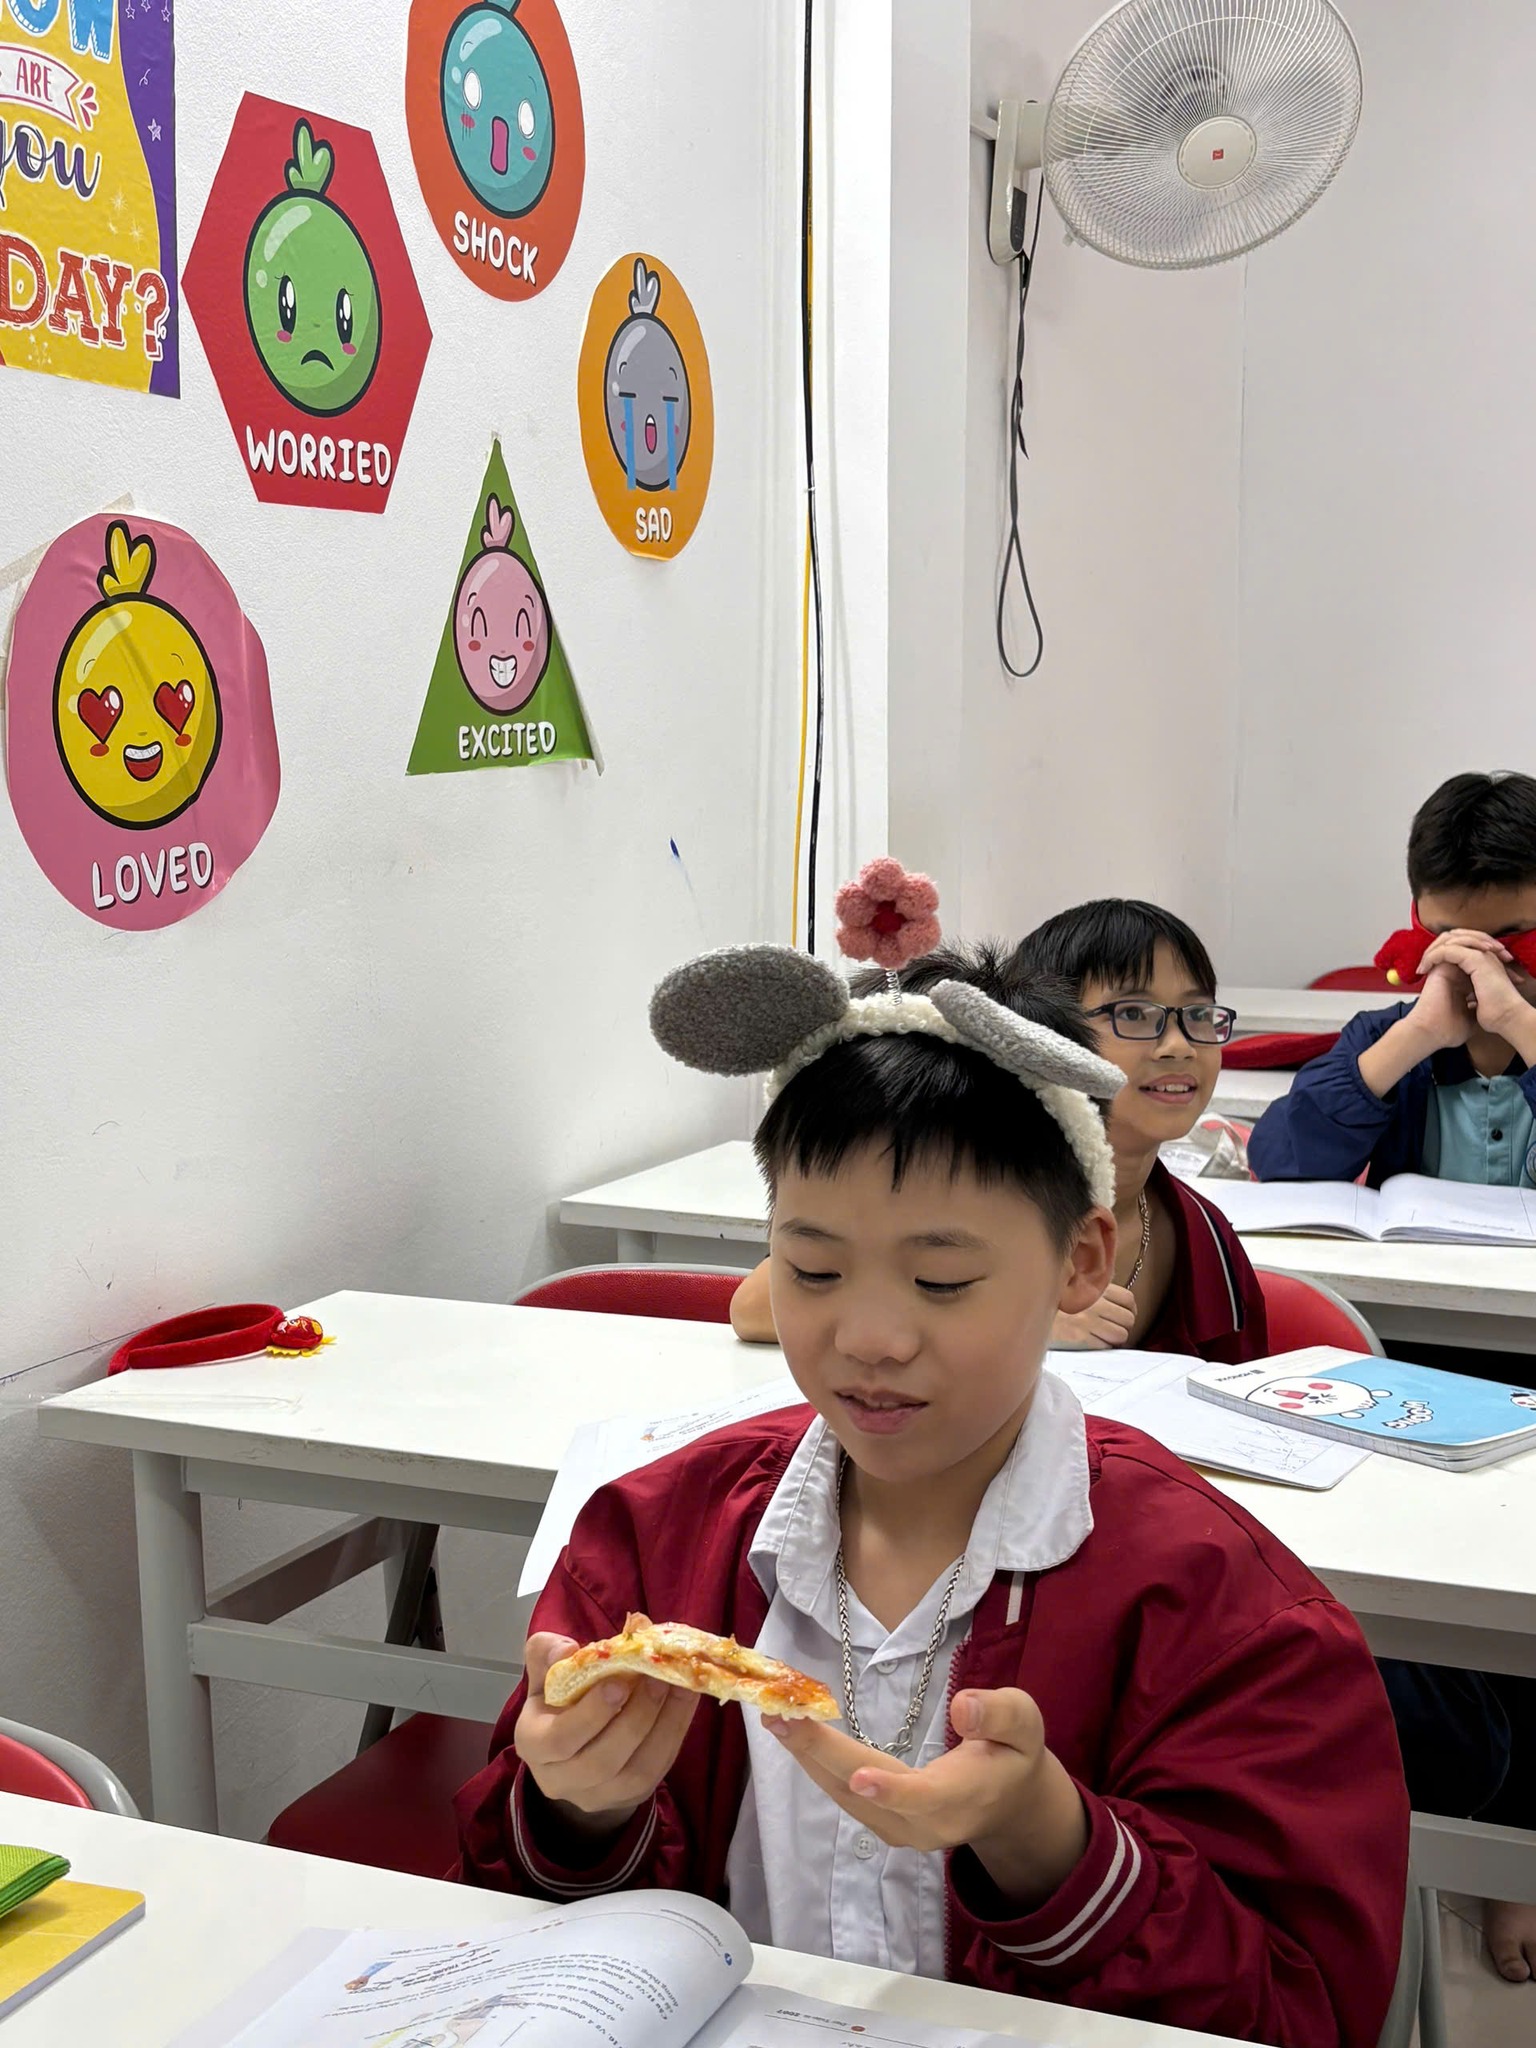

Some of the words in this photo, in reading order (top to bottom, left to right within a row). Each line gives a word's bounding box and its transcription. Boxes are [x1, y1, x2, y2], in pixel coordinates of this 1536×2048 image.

[16, 57, 53, 102] ARE
[453, 210, 539, 285] SHOCK
[0, 238, 169, 359] DAY?
[246, 425, 392, 487] WORRIED
[636, 506, 673, 542] SAD
[458, 721, 557, 760] EXCITED
[91, 841, 213, 909] LOVED
